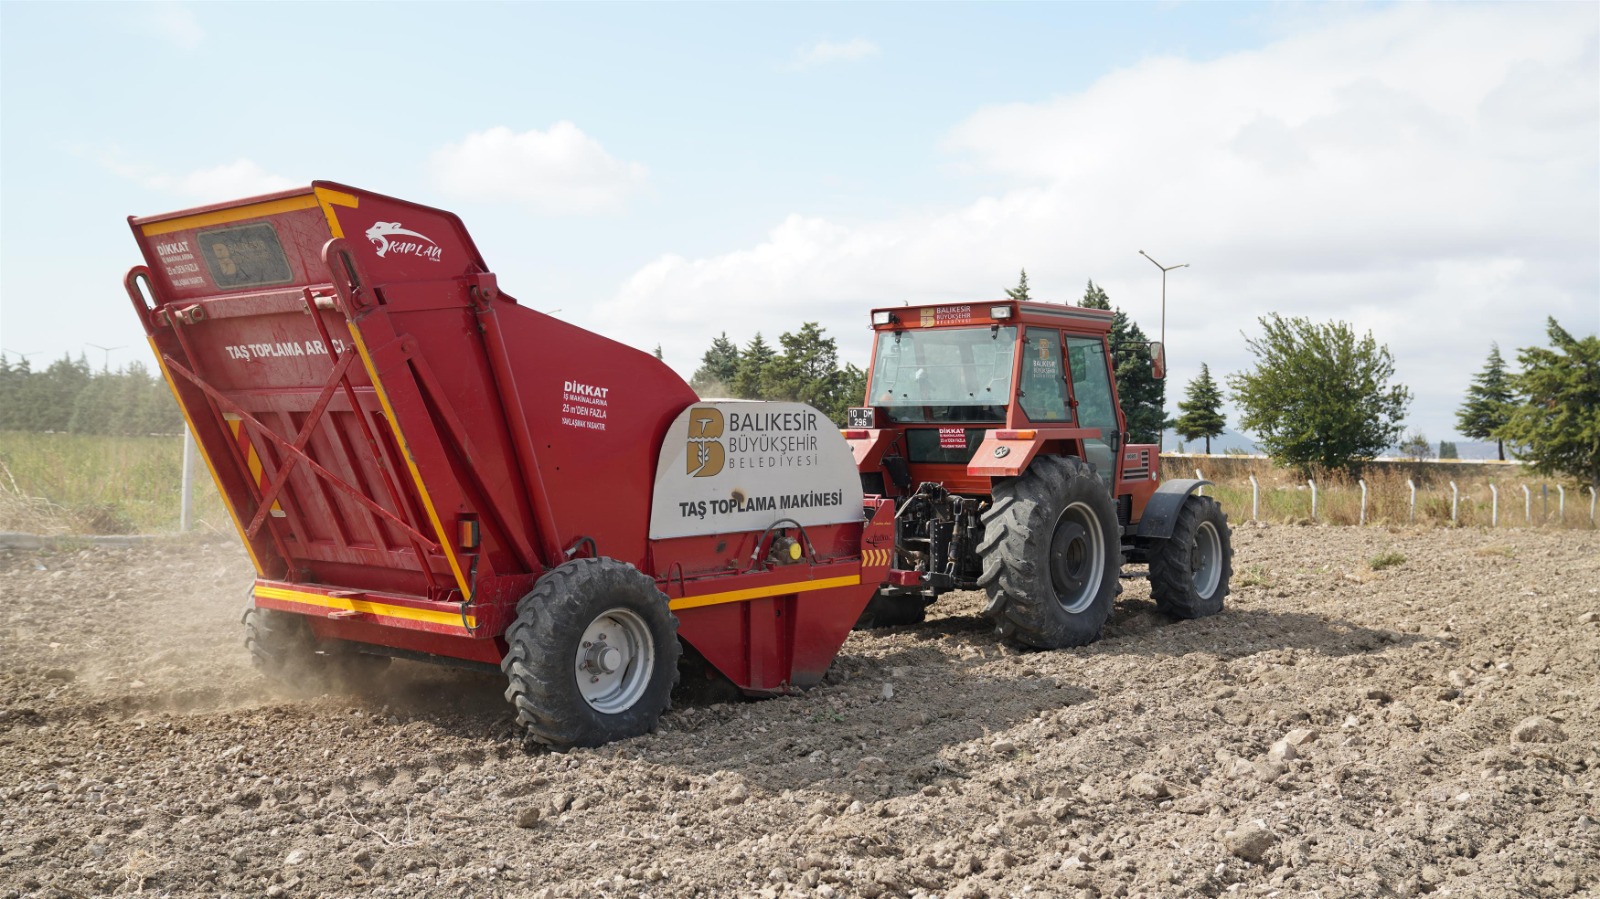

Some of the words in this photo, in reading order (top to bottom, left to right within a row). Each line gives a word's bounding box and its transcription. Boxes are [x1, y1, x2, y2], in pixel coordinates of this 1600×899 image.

[156, 241, 189, 256] DİKKAT
[388, 240, 442, 259] KAPLAN
[936, 305, 971, 315] BALIKESİR
[225, 344, 250, 362] TAŞ
[248, 342, 305, 358] TOPLAMA
[563, 380, 609, 399] DİKKAT
[563, 391, 569, 401] İŞ
[562, 403, 570, 413] 25
[589, 407, 607, 419] FAZLA
[849, 409, 858, 418] 10
[863, 409, 874, 418] DM
[730, 409, 818, 432] BALIKESİR
[854, 417, 867, 427] 296
[729, 433, 818, 455] BÜYÜKŞEHİR
[729, 453, 818, 469] BELEDİYESİ
[679, 501, 707, 520] TAŞ
[710, 495, 777, 515] TOPLAMA
[780, 489, 843, 510] MAKİNESİ
